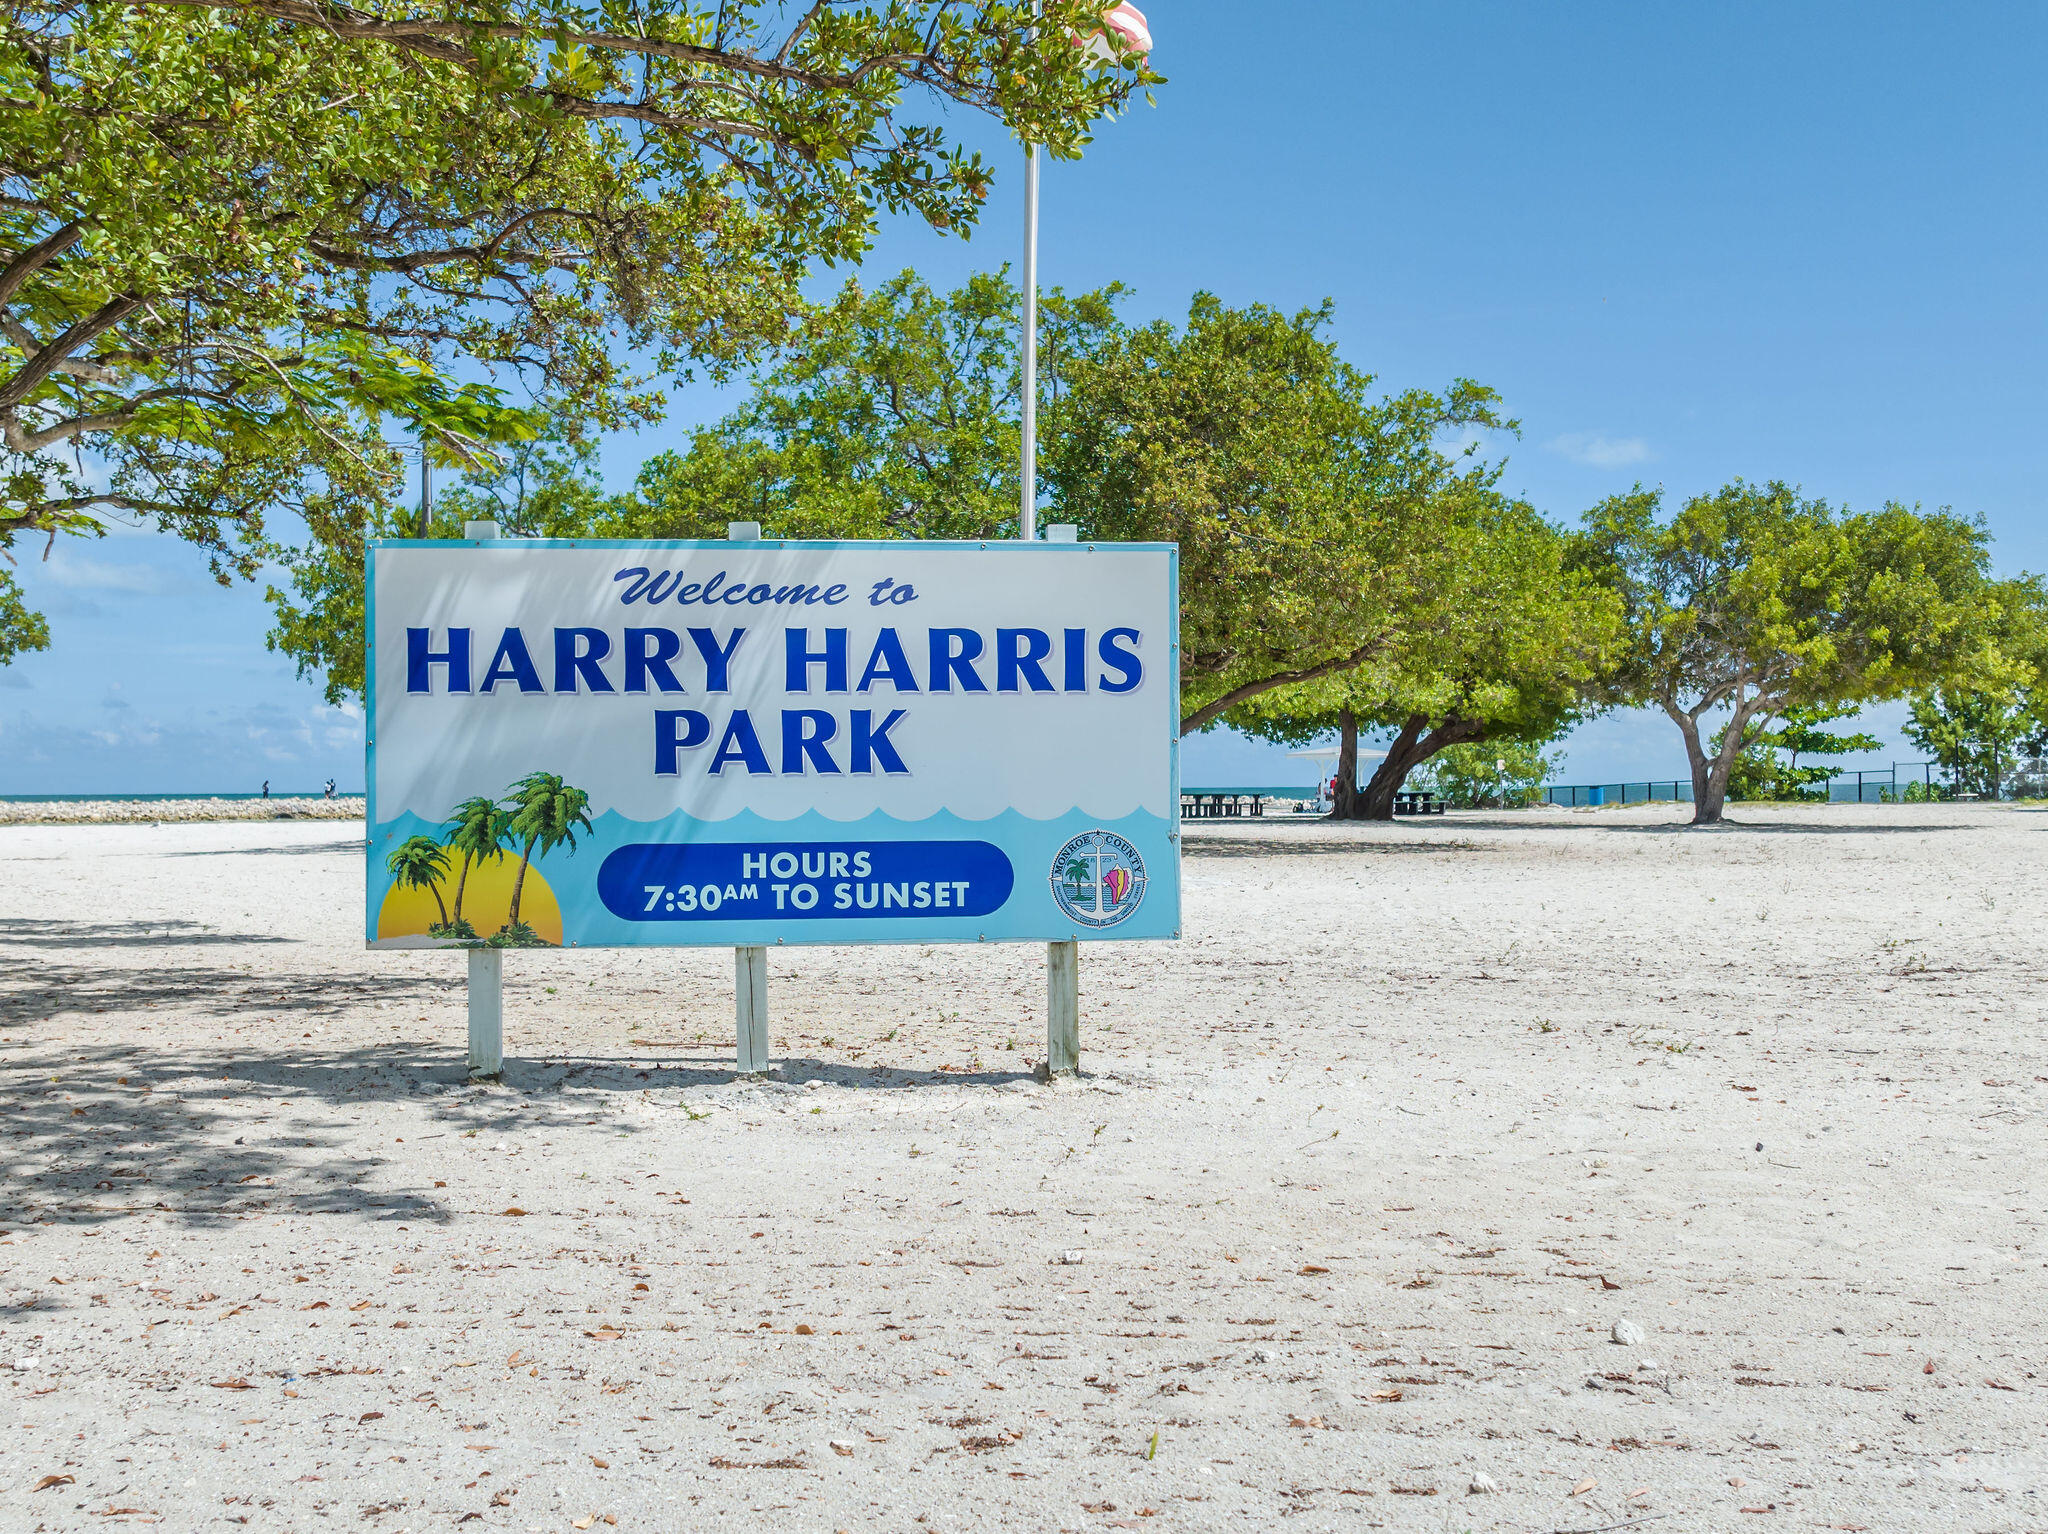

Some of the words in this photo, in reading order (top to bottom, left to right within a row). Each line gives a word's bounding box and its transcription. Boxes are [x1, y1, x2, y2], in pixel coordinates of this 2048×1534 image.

[613, 566, 849, 606] Welcome
[868, 577, 919, 606] to
[406, 626, 750, 696] HARRY
[785, 626, 1146, 696] HARRIS
[654, 708, 911, 777] PARK
[742, 851, 872, 879] HOURS
[1055, 835, 1091, 875] MONROE
[1105, 835, 1143, 874] COUNTY
[771, 884, 819, 910] TO
[833, 881, 970, 909] SUNSET
